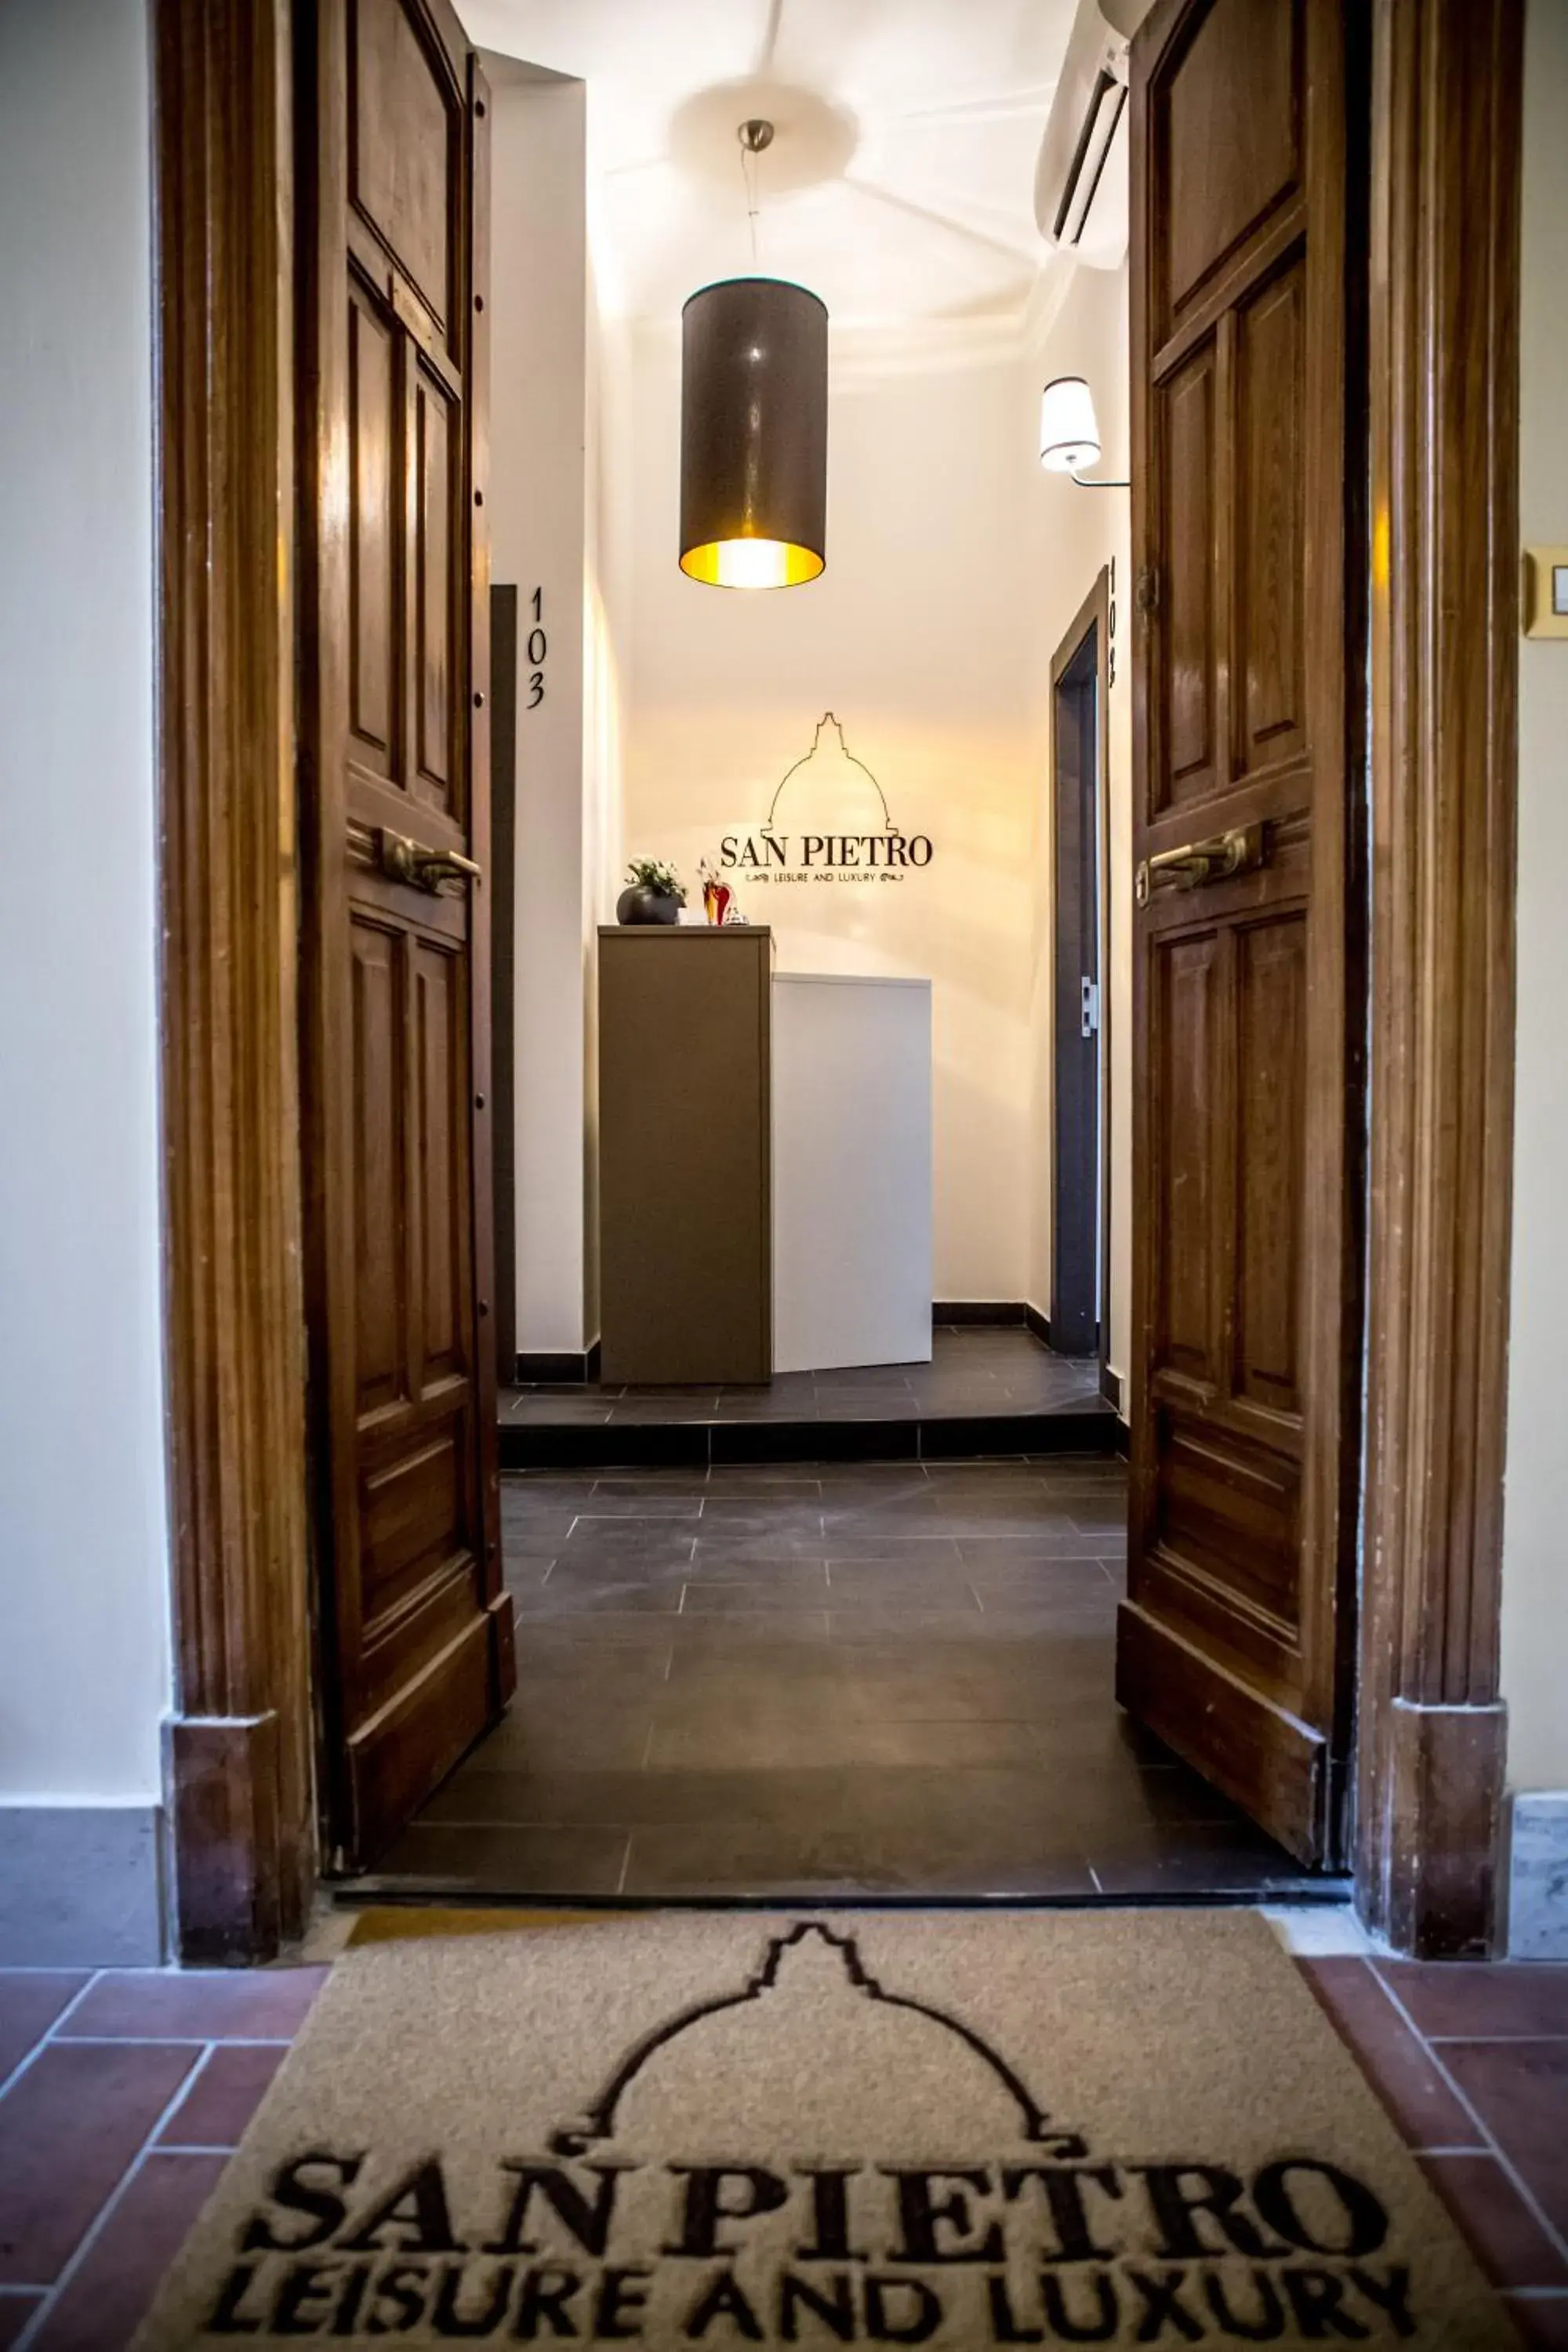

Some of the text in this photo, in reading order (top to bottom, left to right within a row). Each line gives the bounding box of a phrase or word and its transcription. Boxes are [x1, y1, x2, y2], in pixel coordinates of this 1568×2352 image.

[526, 586, 547, 710] 103
[720, 834, 934, 868] SAN PIETRO
[774, 872, 876, 883] LEISURE AND LUXURY
[238, 2151, 1391, 2263] SAN PIETRO
[201, 2259, 1419, 2344] LEISURE AND LUXURY
